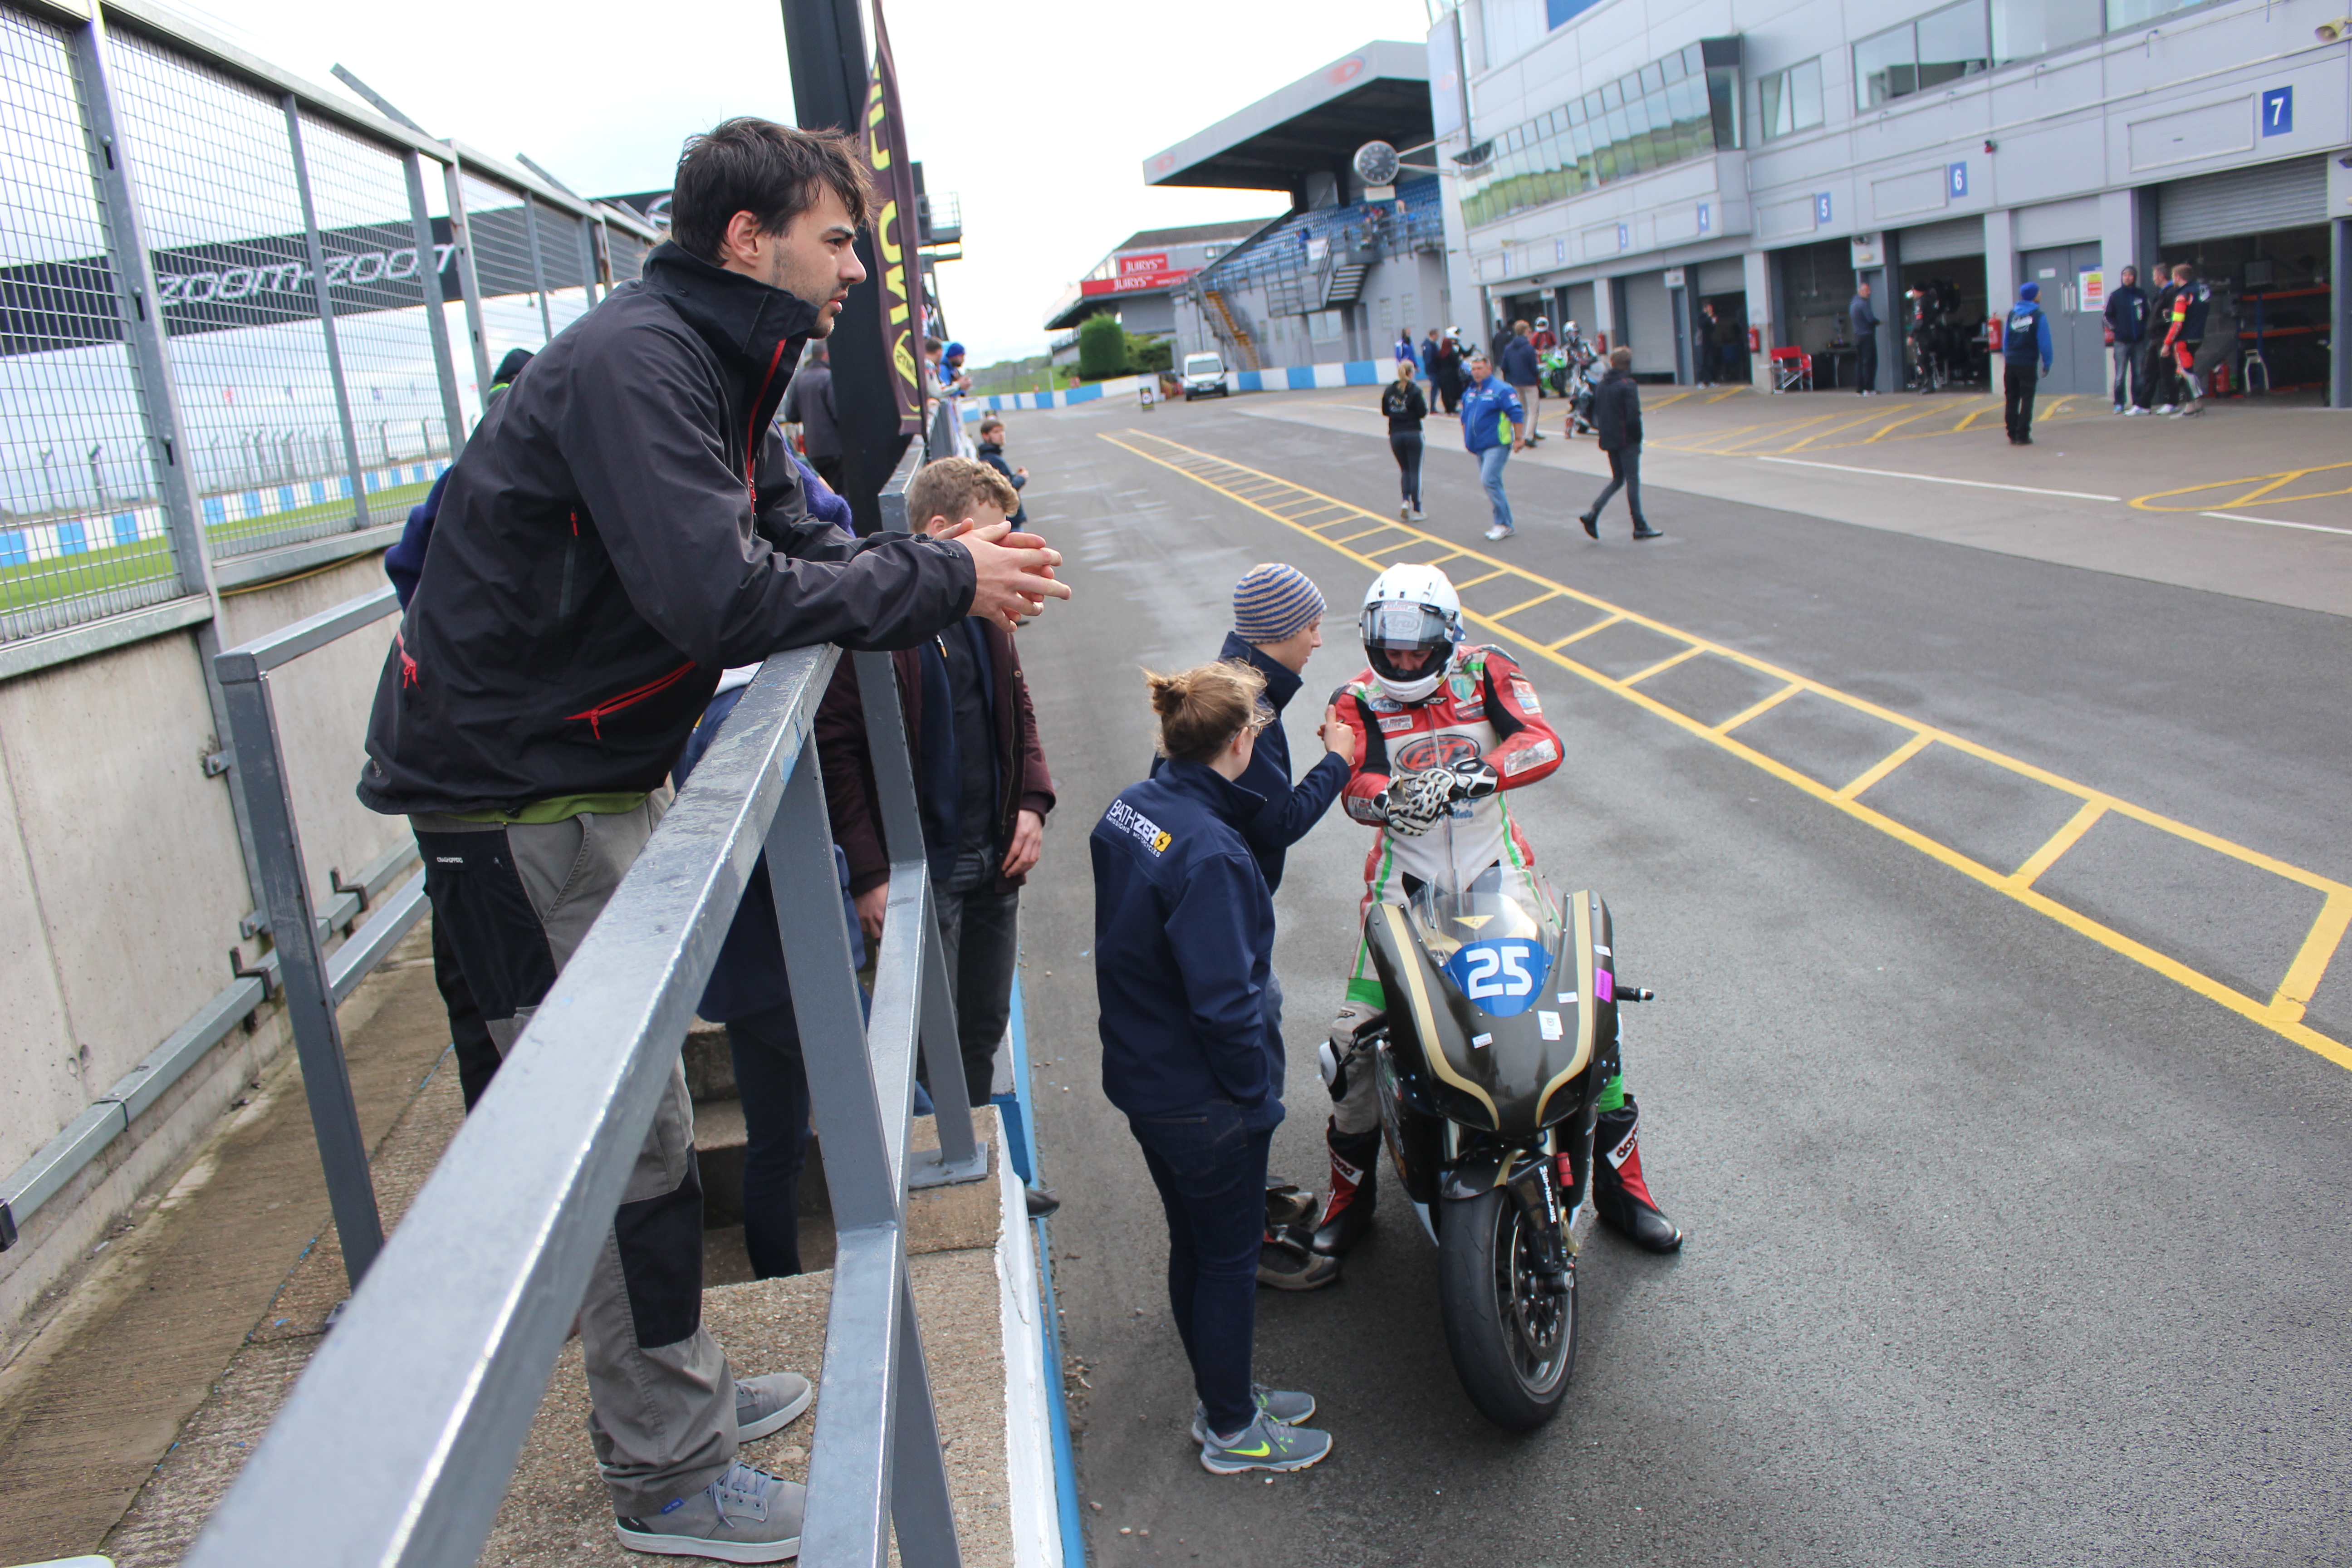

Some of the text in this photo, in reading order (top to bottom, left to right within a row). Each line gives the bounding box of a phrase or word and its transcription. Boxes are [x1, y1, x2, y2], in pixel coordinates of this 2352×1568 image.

[2271, 97, 2284, 126] 7
[1955, 169, 1963, 191] 6
[1701, 209, 1707, 226] 4
[1821, 198, 1828, 218] 5
[1622, 228, 1627, 245] 3
[1125, 257, 1158, 274] JURYS
[1113, 275, 1147, 292] JURYS
[1106, 814, 1161, 858] EMISSIONS MOTORCYCLES
[1465, 946, 1533, 1000] 25
